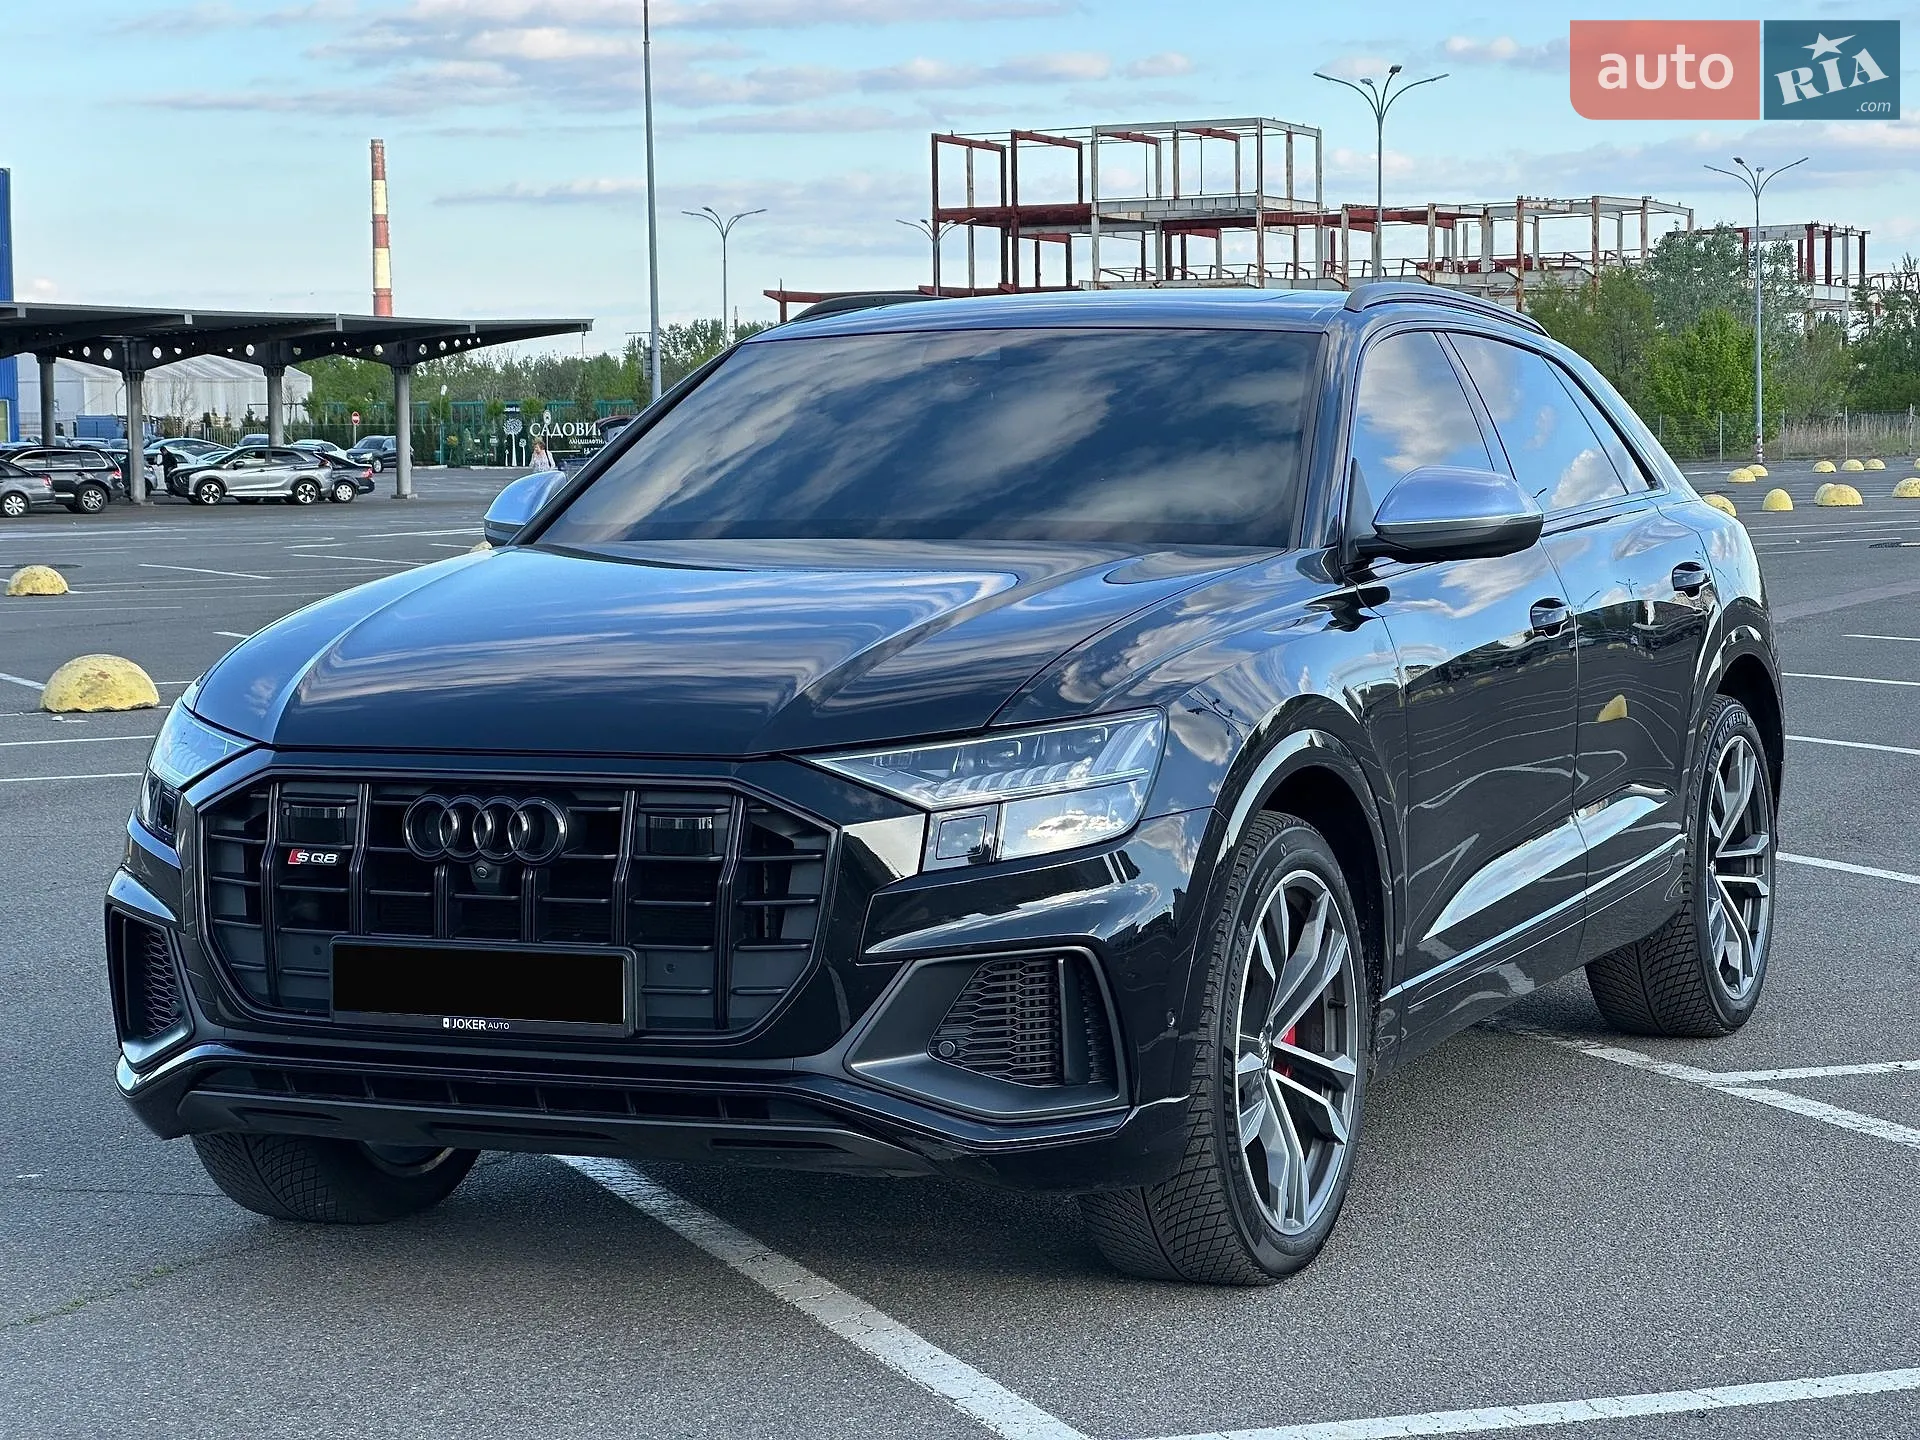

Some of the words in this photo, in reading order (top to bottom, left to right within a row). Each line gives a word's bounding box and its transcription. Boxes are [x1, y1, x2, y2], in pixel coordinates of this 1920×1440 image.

[1718, 712, 1747, 748] MICHELIN
[296, 852, 338, 863] SQ8
[452, 1018, 486, 1030] JOKER
[487, 1022, 510, 1030] AUTO
